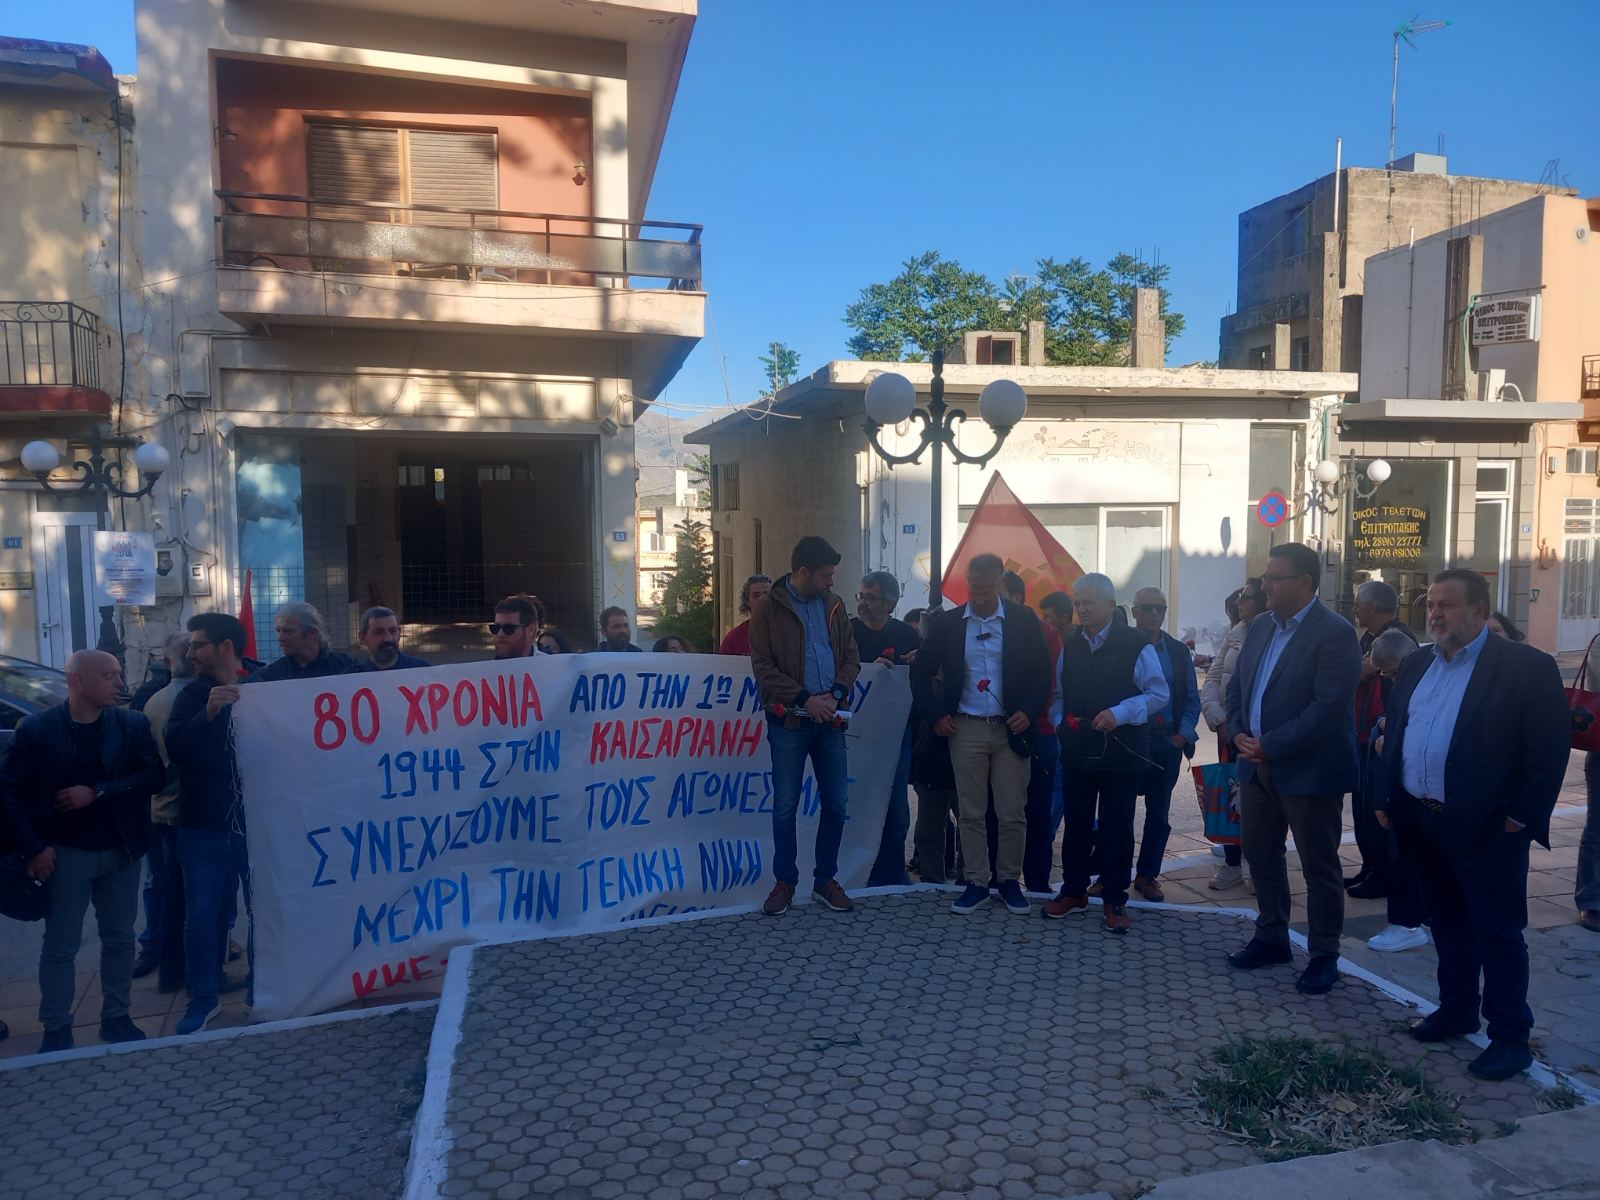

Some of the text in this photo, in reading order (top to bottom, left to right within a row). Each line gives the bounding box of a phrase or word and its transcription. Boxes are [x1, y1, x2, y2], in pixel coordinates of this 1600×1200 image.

[1372, 536, 1395, 547] 28910
[313, 687, 380, 751] 80
[398, 672, 543, 736] ΧΡΟΝΙΑ
[570, 672, 626, 713] ΑΠΟ
[636, 672, 690, 709] ΤΗΝ
[377, 715, 763, 800] 1944 ΣΤΗΝ ΚΑΙΣΑΡΙΑΝΗ
[306, 794, 562, 888] ΣΥΝΕΧΙΖΟΥΜΕ
[585, 775, 656, 831] ΤΟΥΣ
[667, 770, 774, 818] ΑΓΩΝΕΣ
[352, 838, 762, 950] ΜΕΧΡΙ ΤΗΝ ΤΕΛΙΚΗ ΝΙΚΗ
